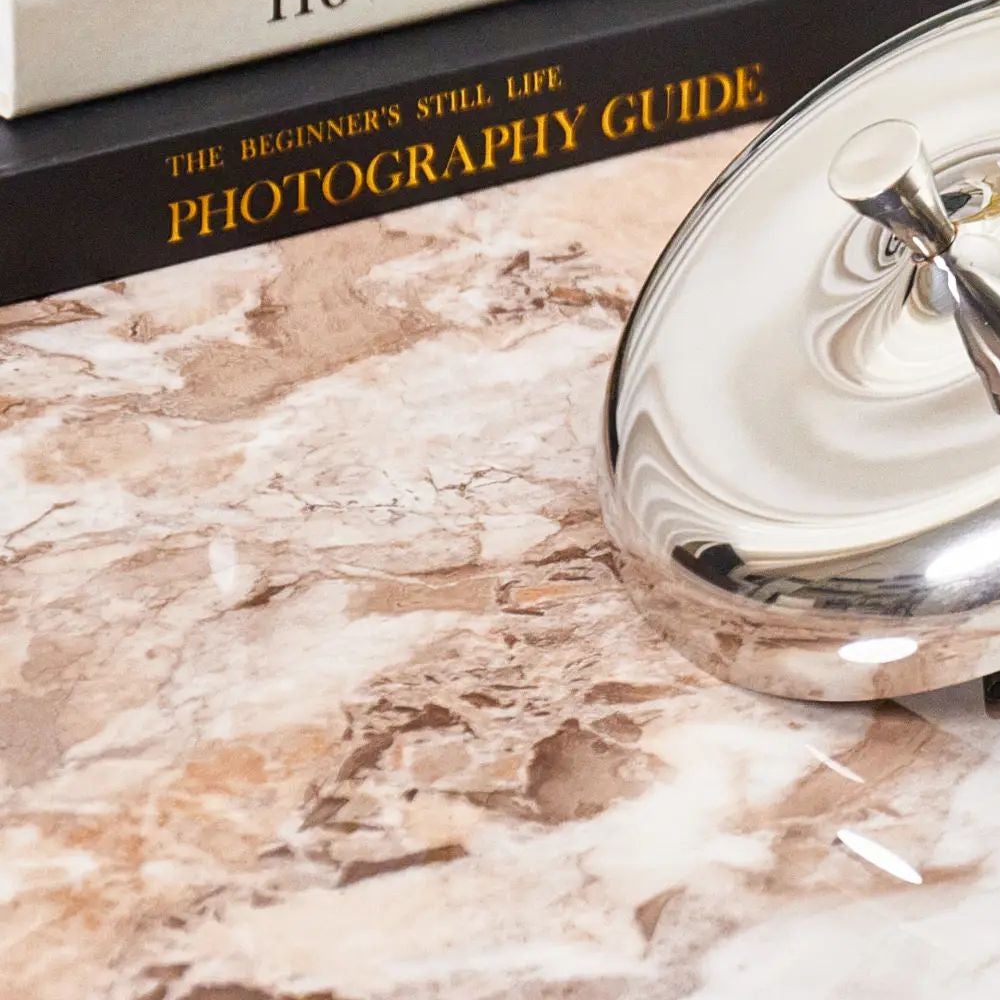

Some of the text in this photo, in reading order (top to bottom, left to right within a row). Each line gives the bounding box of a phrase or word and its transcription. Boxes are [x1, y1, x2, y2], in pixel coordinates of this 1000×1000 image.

[165, 64, 563, 178] THE BEGINNER'S STILL LIFE
[166, 62, 767, 244] PHOTOGRAPHY GUIDE
